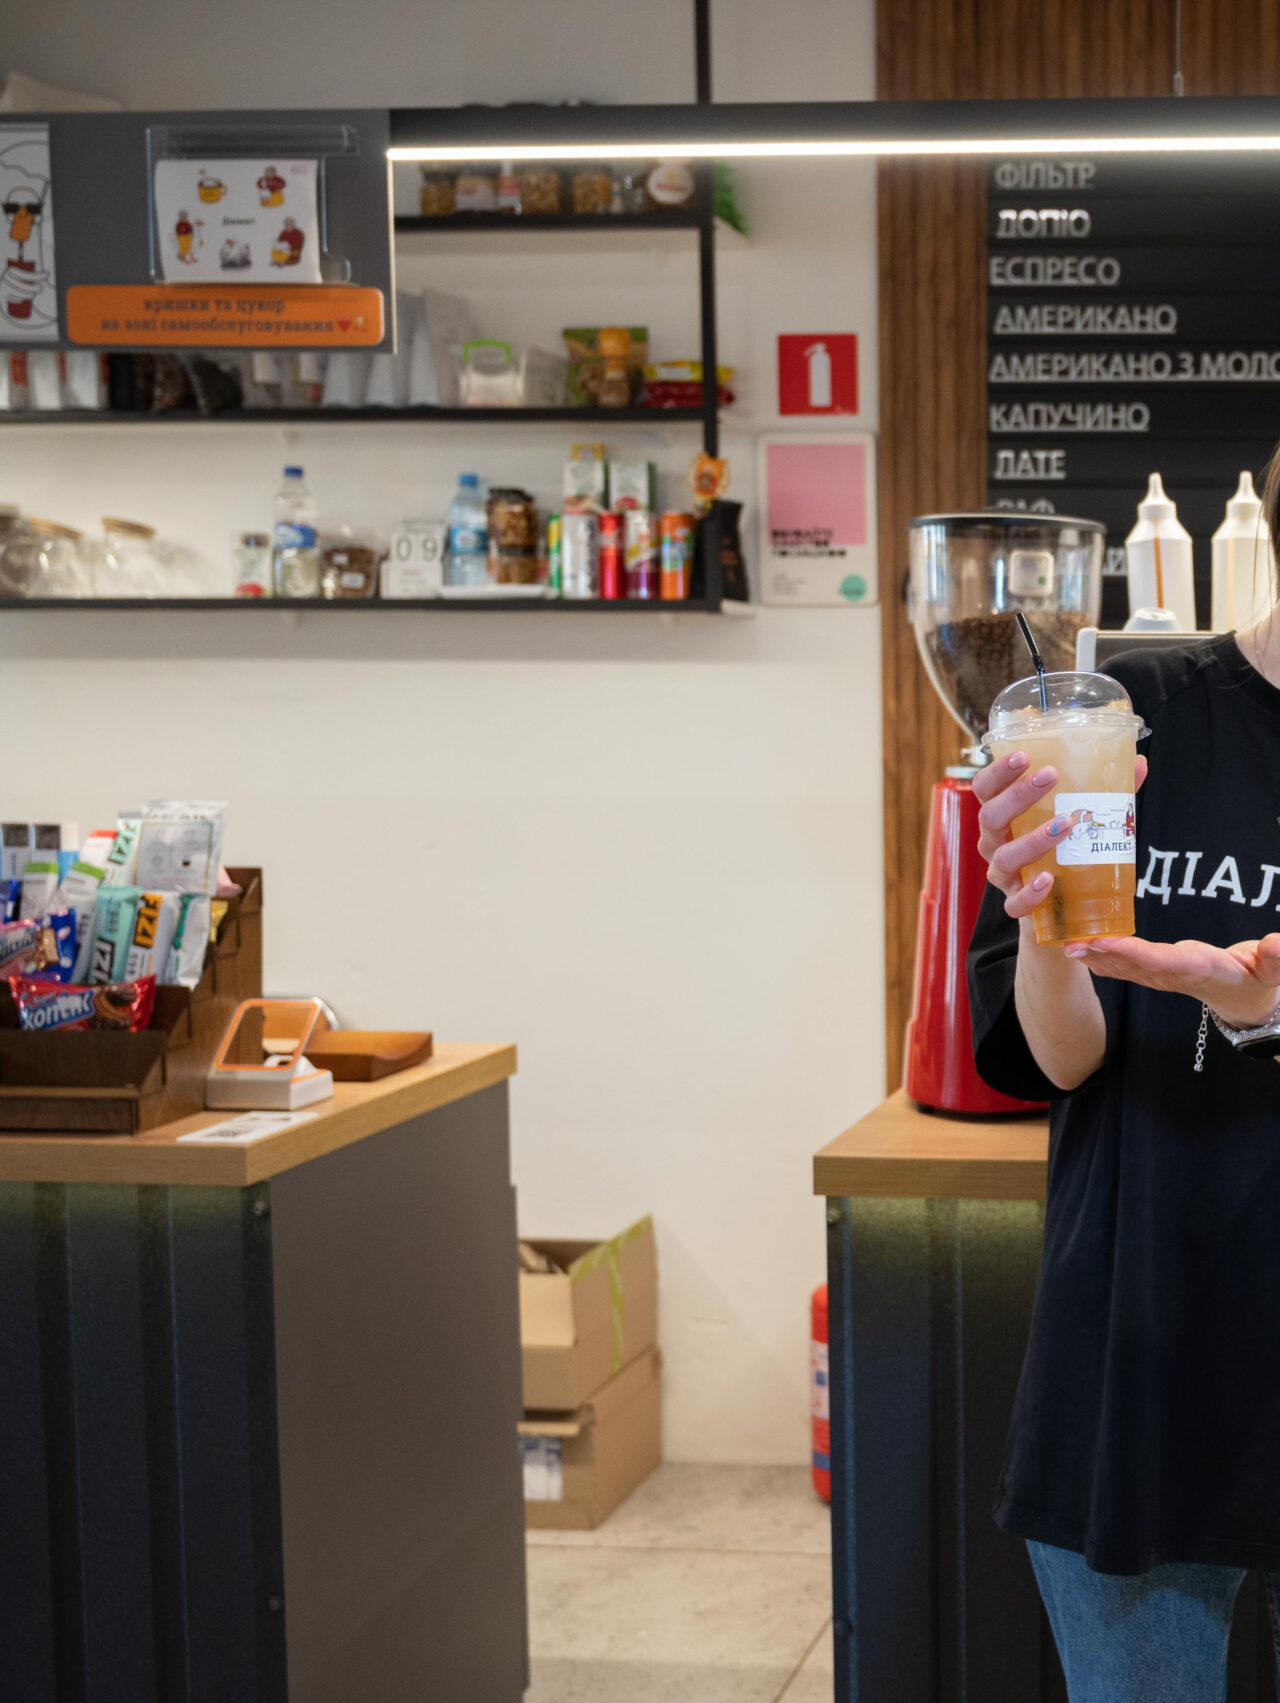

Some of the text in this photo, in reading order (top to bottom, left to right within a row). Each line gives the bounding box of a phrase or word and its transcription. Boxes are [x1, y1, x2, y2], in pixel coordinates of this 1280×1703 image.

[994, 161, 1095, 189] ФІЛЬТР
[997, 209, 1091, 238] ДОПІО
[990, 257, 1121, 286] ЕСПРЕСО
[214, 301, 232, 311] та
[994, 305, 1177, 334] АМЕРИКАНО
[989, 353, 1172, 382] АМЕРИКАНО
[990, 403, 1150, 432] КАПУЧИНО
[994, 450, 1066, 479] ЛАТЕ
[1091, 842, 1132, 854] ДІАЛЕКТ
